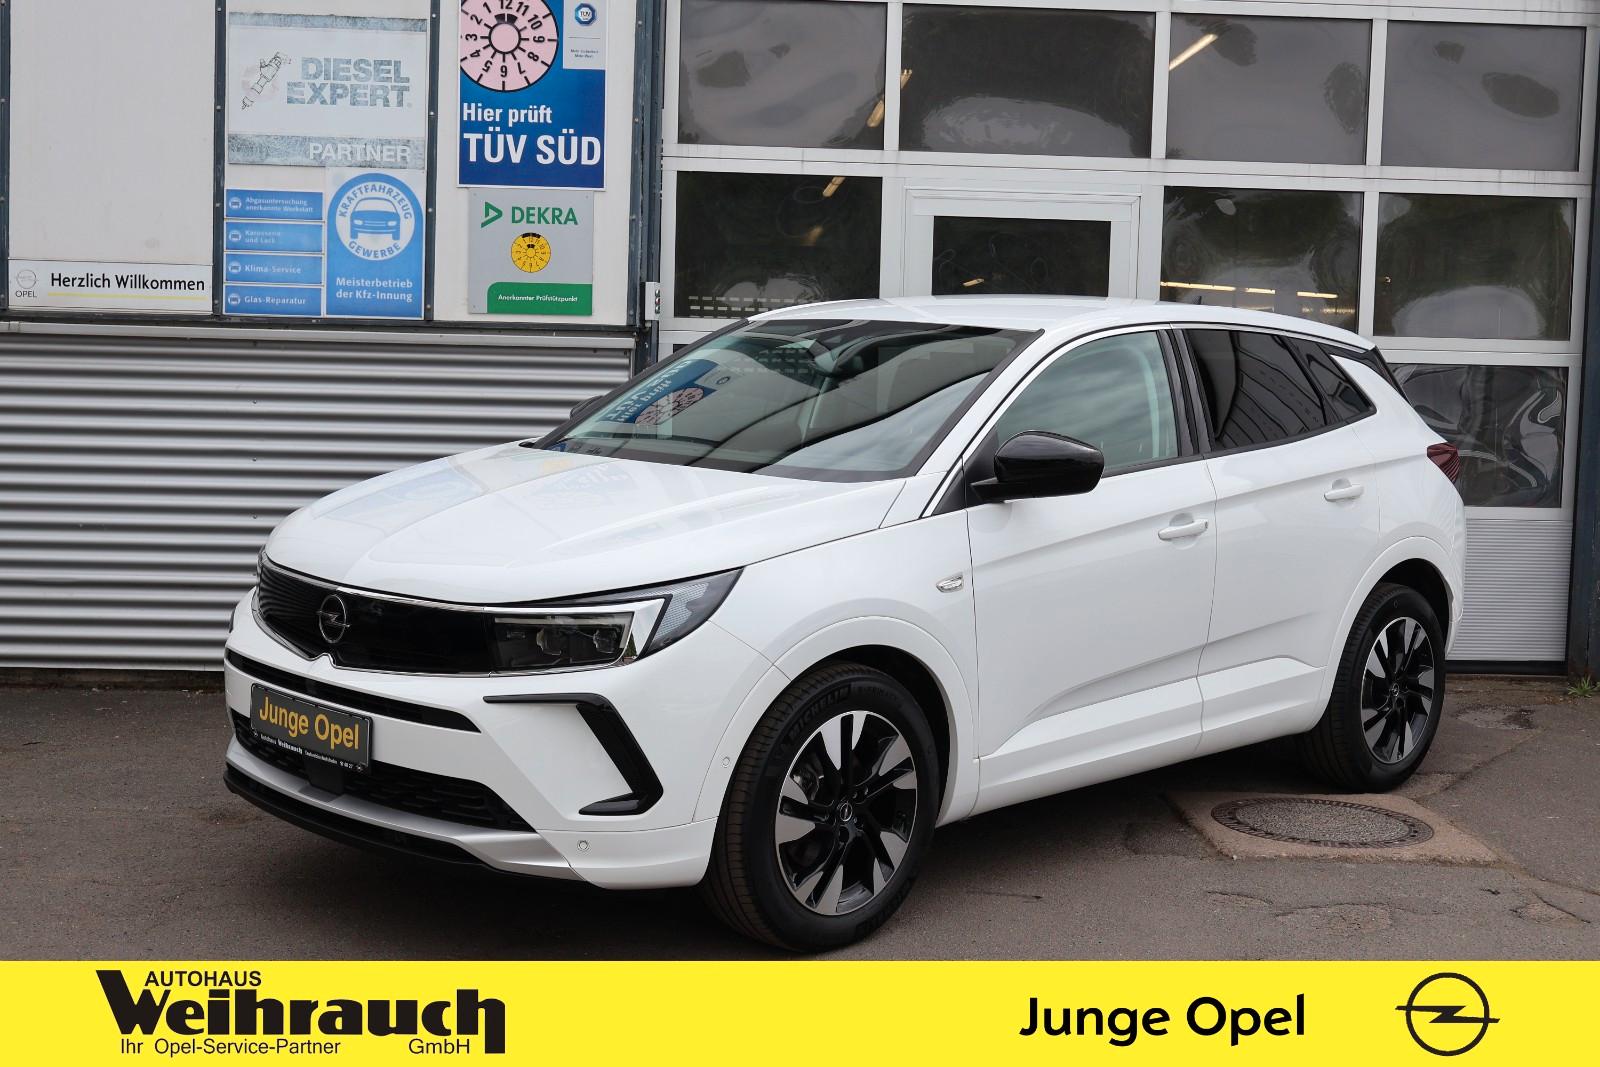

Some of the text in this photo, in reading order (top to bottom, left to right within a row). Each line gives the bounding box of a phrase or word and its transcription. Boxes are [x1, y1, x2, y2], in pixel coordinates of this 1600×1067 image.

[483, 2, 492, 13] 1
[500, 0, 513, 10] 12
[516, 1, 530, 16] 11
[470, 14, 483, 25] 2
[528, 14, 543, 30] 10
[465, 33, 478, 41] 3
[470, 49, 481, 58] 4
[527, 51, 539, 62] 8
[301, 57, 410, 83] DIESEL
[482, 60, 493, 73] 5
[517, 62, 526, 74] 7
[287, 81, 410, 108] EXPERT
[463, 103, 552, 127] Hier prüft
[309, 142, 410, 162] PARTNER
[463, 127, 601, 165] TÜV SÜD
[245, 196, 308, 206] Abgasuntersuchung
[339, 184, 412, 220] KRAFTFAHRZEUG
[511, 206, 578, 226] DEKRA
[348, 240, 401, 258] GEWERBE
[244, 264, 302, 274] Klima-Service
[51, 273, 205, 291] Herzlich Willkommen
[336, 277, 413, 288] Meisterbetrieb
[15, 290, 37, 298] OPEL
[244, 296, 306, 305] Glas-Reparatur
[336, 289, 413, 302] der Kfz-Innung
[498, 294, 578, 303] Anerkannter Prüfstützpunkt
[788, 684, 851, 742] MICHELIN
[260, 696, 359, 750] Junge Opel
